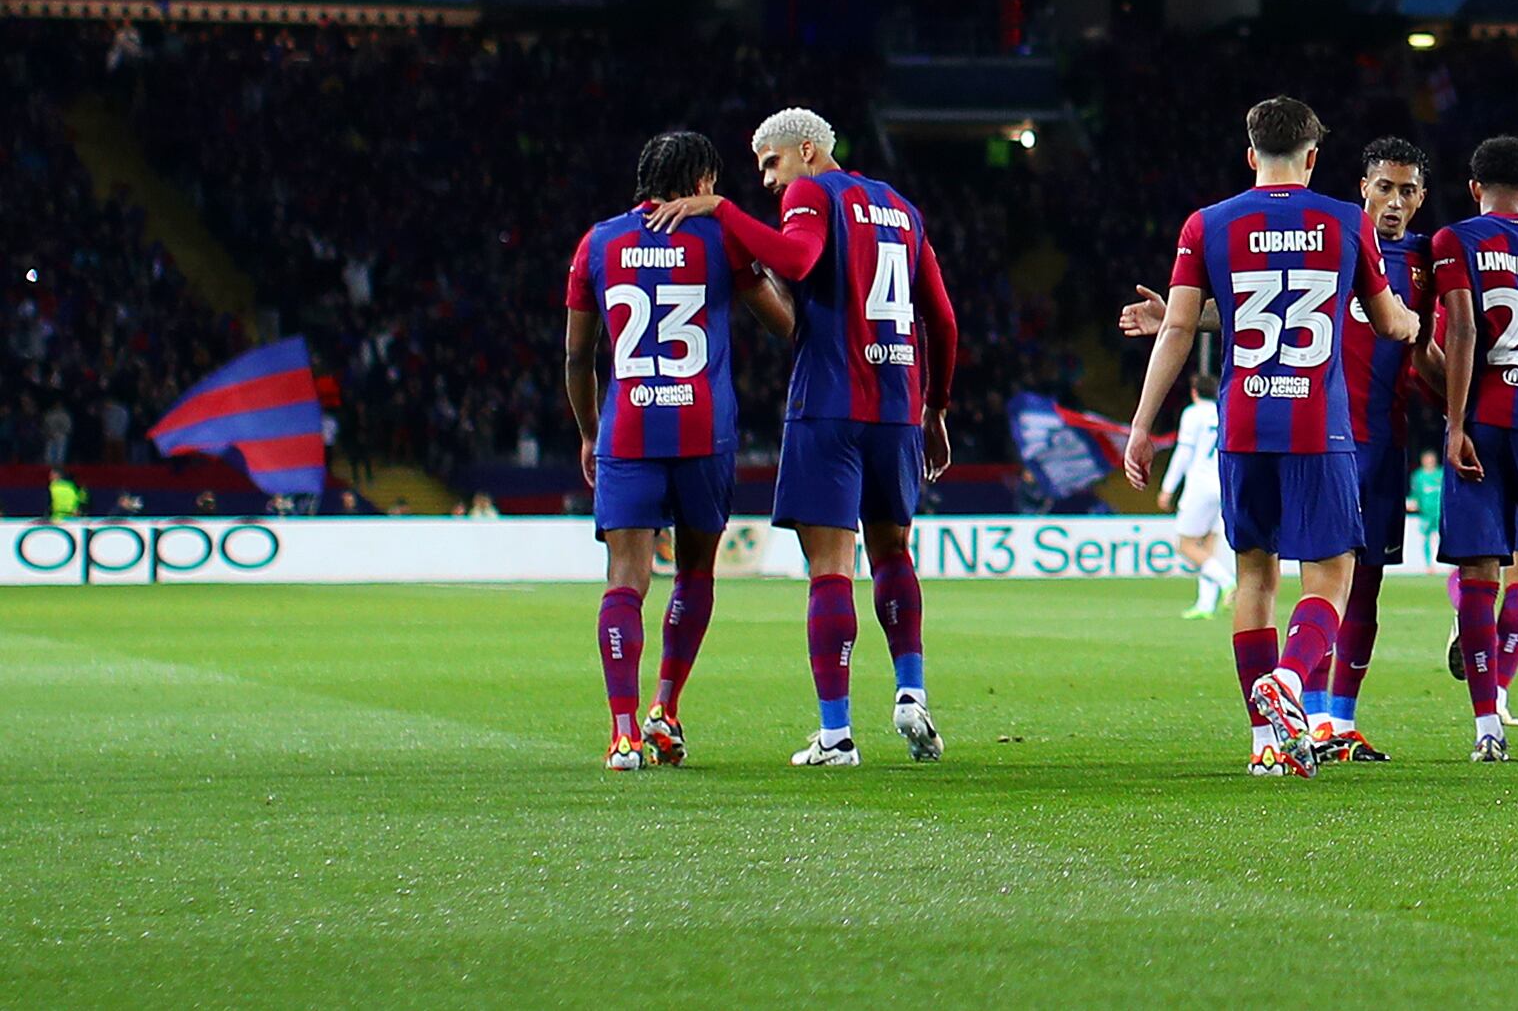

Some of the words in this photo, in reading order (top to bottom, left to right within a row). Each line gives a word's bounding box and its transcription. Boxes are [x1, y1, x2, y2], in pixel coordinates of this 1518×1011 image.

[621, 246, 686, 269] KOUNDE
[1249, 223, 1325, 252] CUBARSÍ
[866, 242, 914, 335] 4
[605, 284, 707, 379] 23
[1230, 269, 1339, 368] 33
[1270, 376, 1310, 387] UNHCR
[15, 525, 280, 585] oppo
[938, 526, 1016, 573] N3
[607, 627, 623, 659] BARÇA
